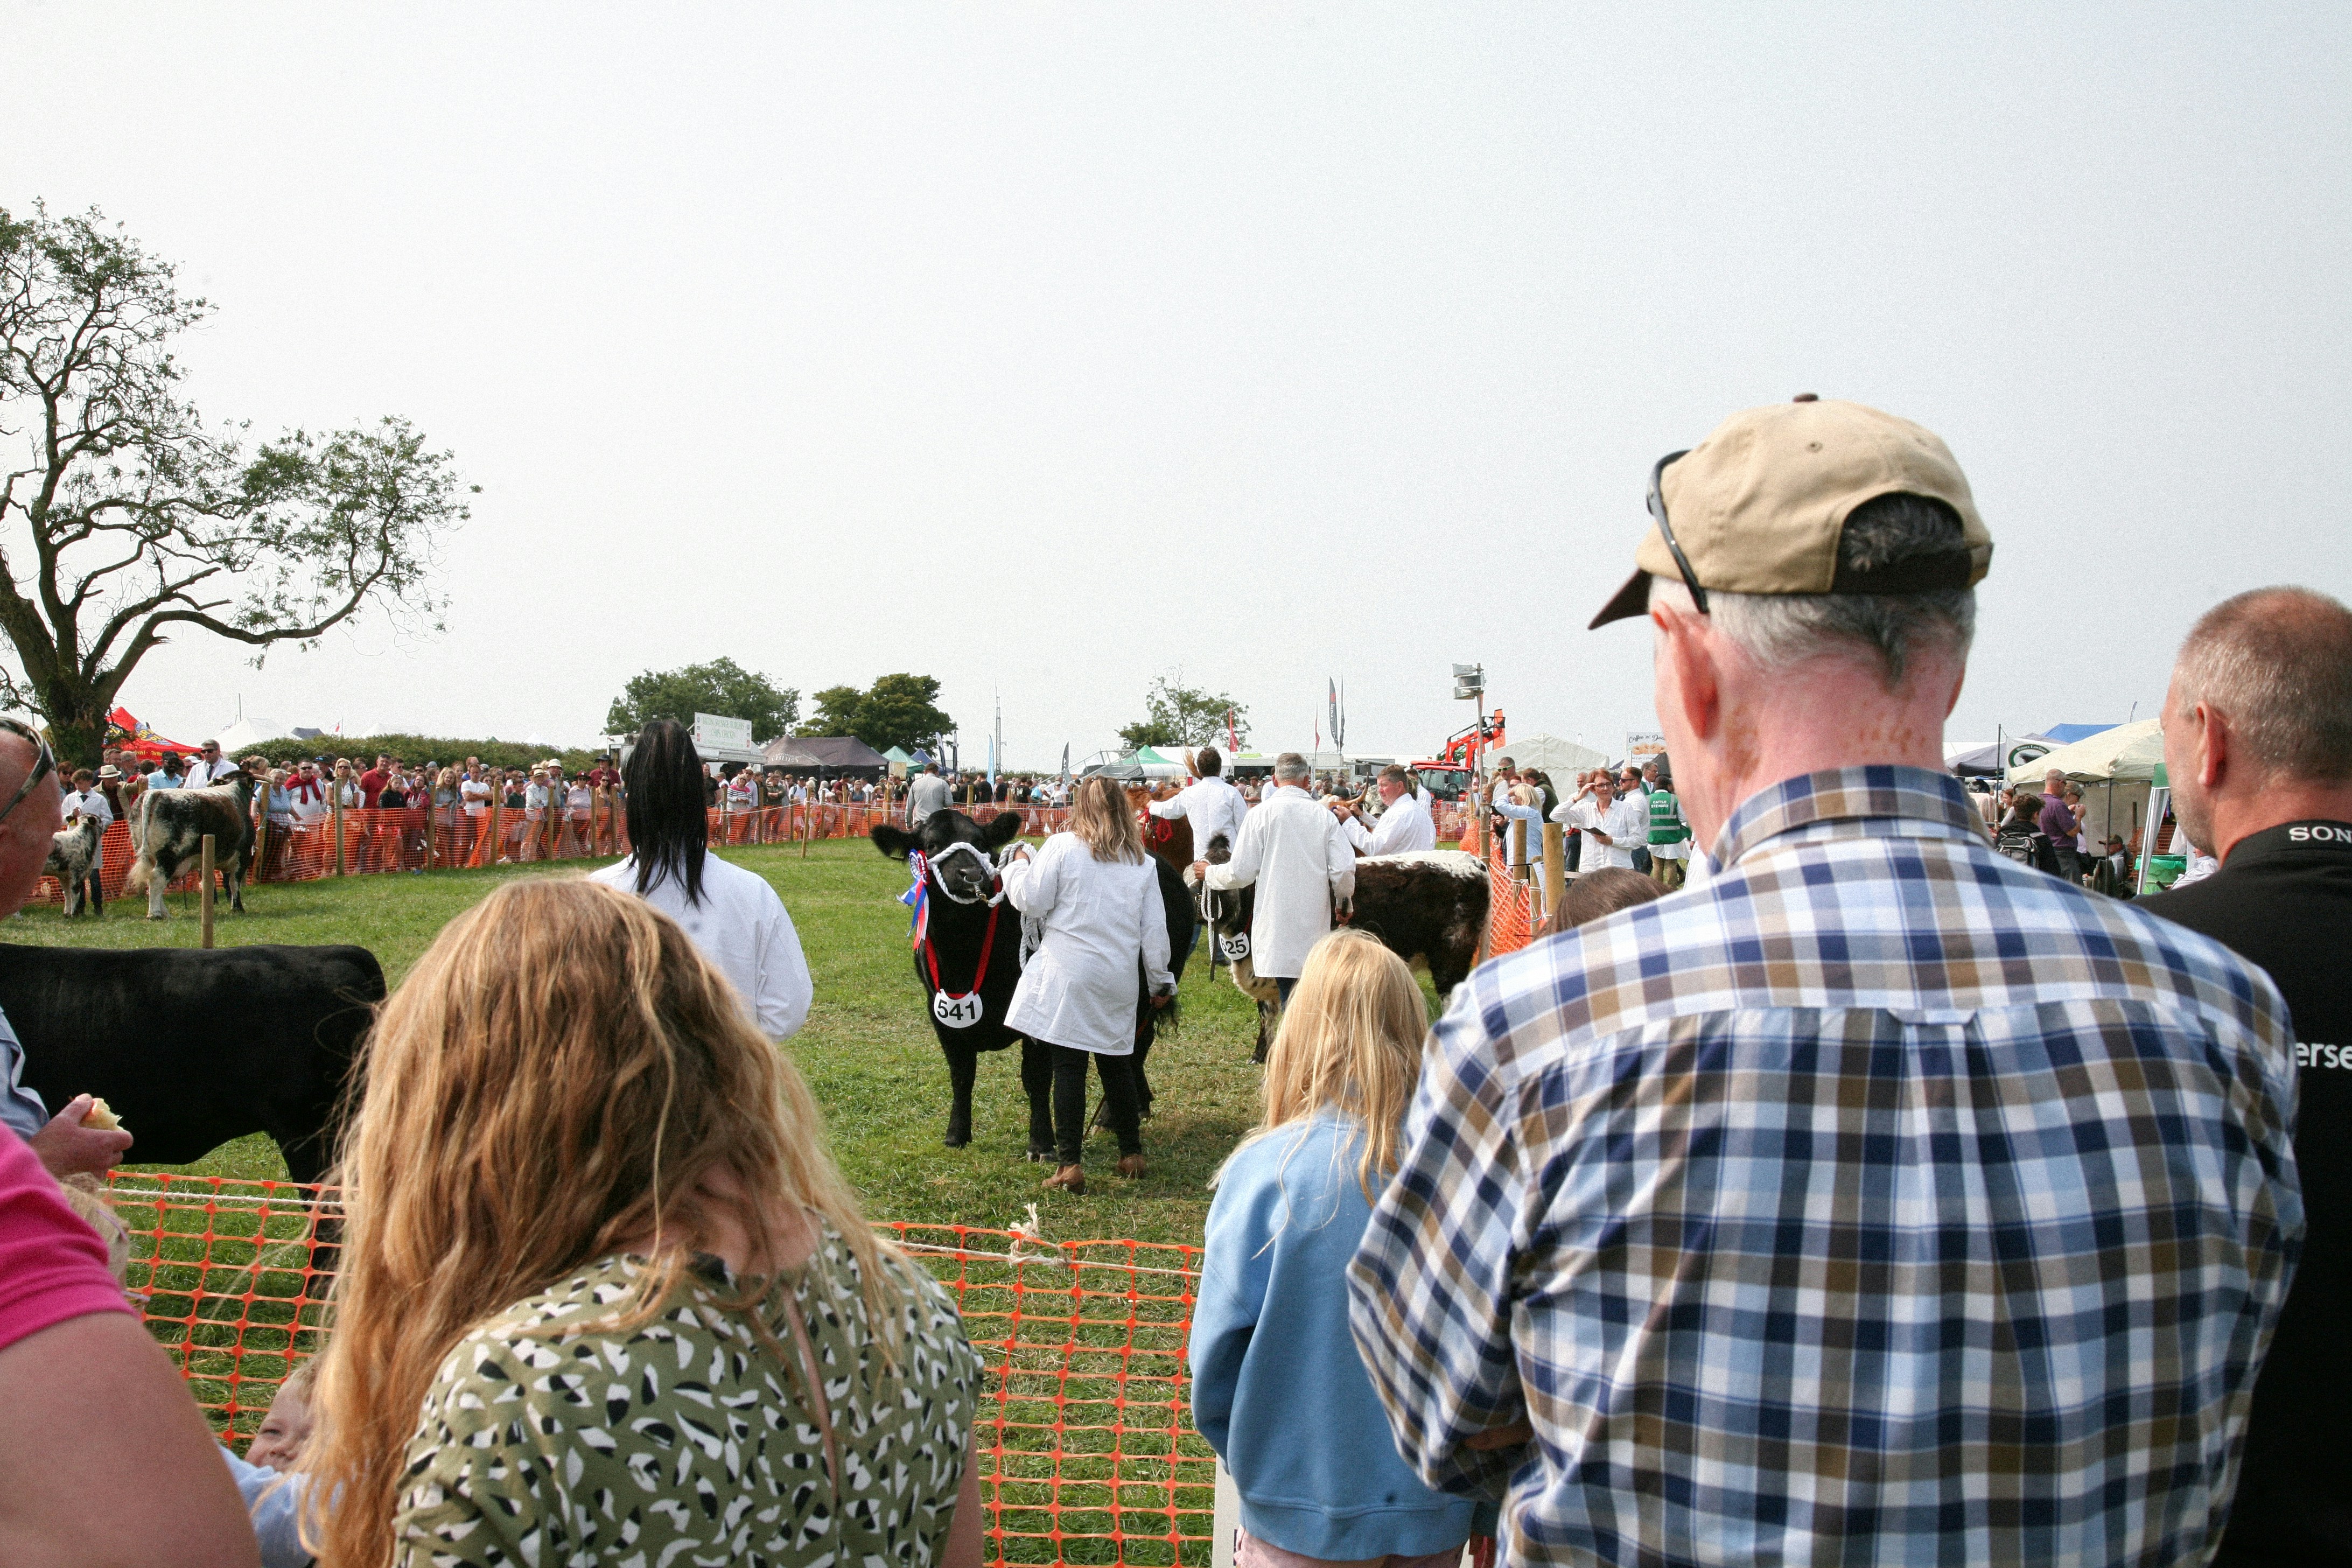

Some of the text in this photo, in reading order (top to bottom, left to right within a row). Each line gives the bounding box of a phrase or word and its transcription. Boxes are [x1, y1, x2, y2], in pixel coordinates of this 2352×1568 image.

[1628, 734, 1644, 743] Coffee
[1221, 937, 1247, 954] 625
[937, 999, 976, 1020] 541
